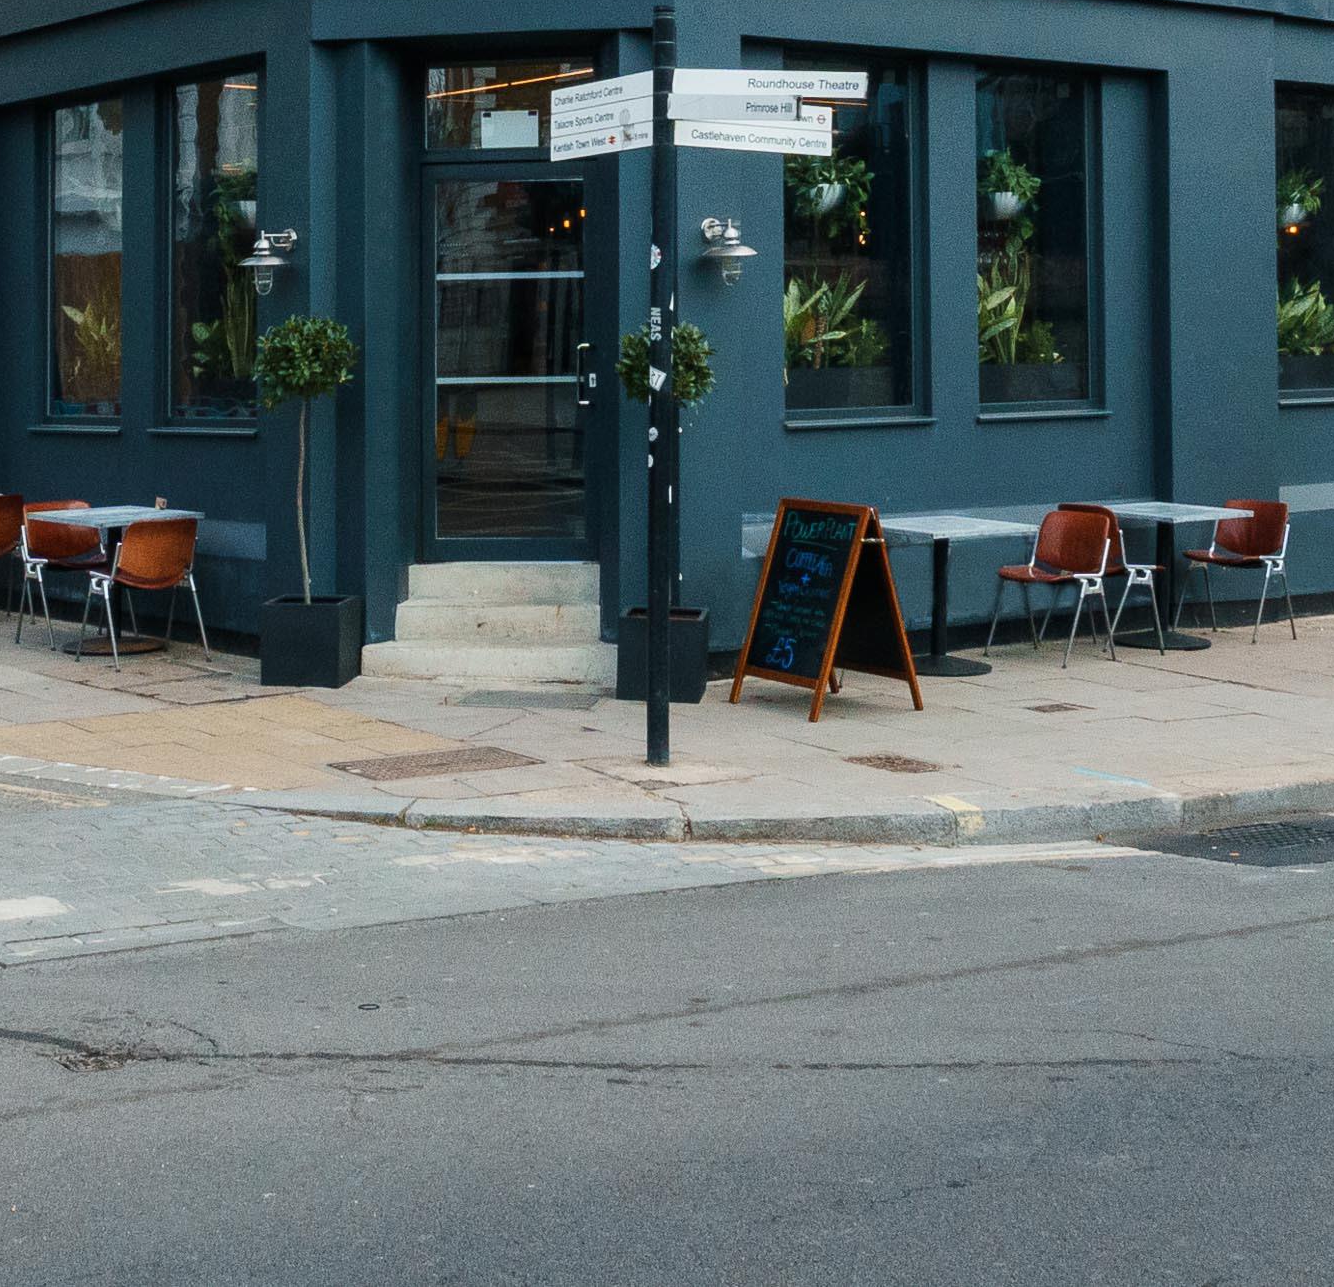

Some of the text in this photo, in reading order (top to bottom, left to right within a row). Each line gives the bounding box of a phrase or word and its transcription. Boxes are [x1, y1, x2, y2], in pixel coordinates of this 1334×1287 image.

[748, 78, 859, 90] Roundhouse Theatre
[553, 86, 623, 107] Charlie Ratchford Centre
[746, 102, 793, 114] Primrose Hill
[554, 112, 614, 129] Talacre Sports Centre
[553, 136, 607, 153] Kentish Town West
[691, 129, 827, 149] Castlehaven Community Centre
[766, 636, 797, 669] £5
